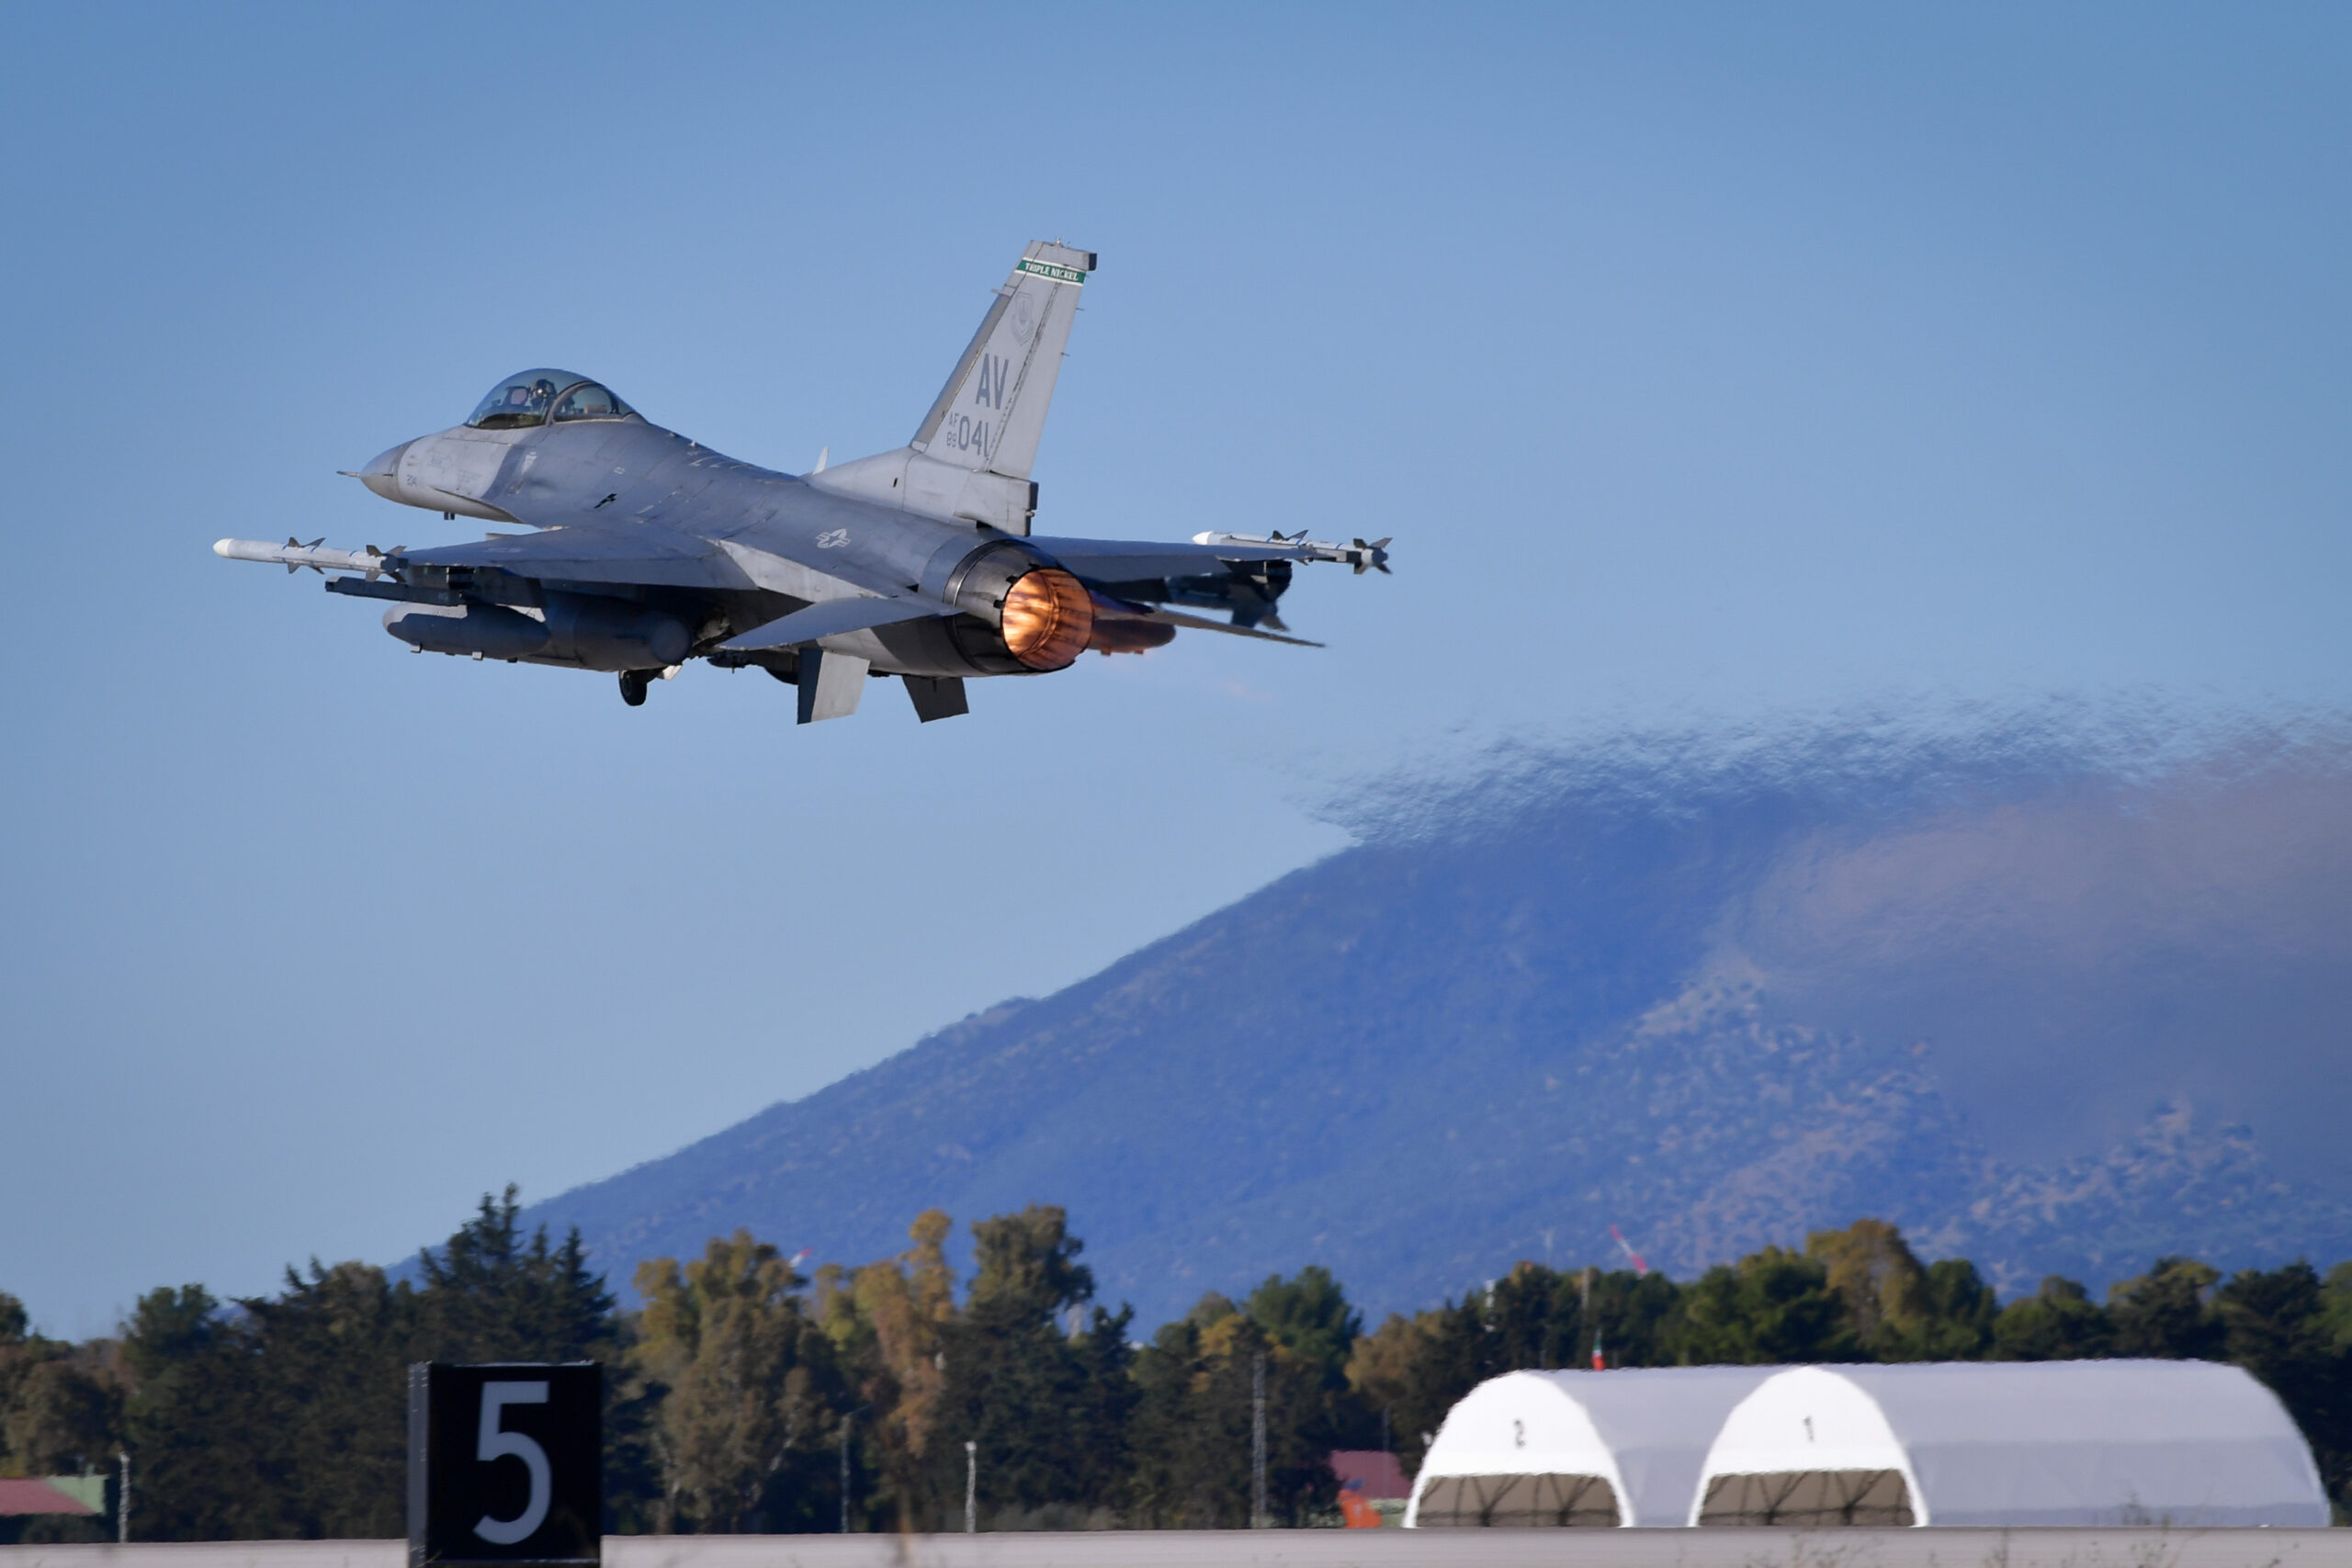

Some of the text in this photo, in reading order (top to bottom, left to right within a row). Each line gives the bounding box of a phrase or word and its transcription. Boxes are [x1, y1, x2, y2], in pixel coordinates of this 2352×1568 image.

[1025, 263, 1079, 281] TRIPLE NICKEL
[976, 353, 1009, 410] AV
[949, 412, 960, 427] AF
[958, 415, 989, 457] 041
[1513, 1418, 1526, 1450] 2
[1803, 1416, 1815, 1443] 1
[472, 1381, 551, 1545] 5
